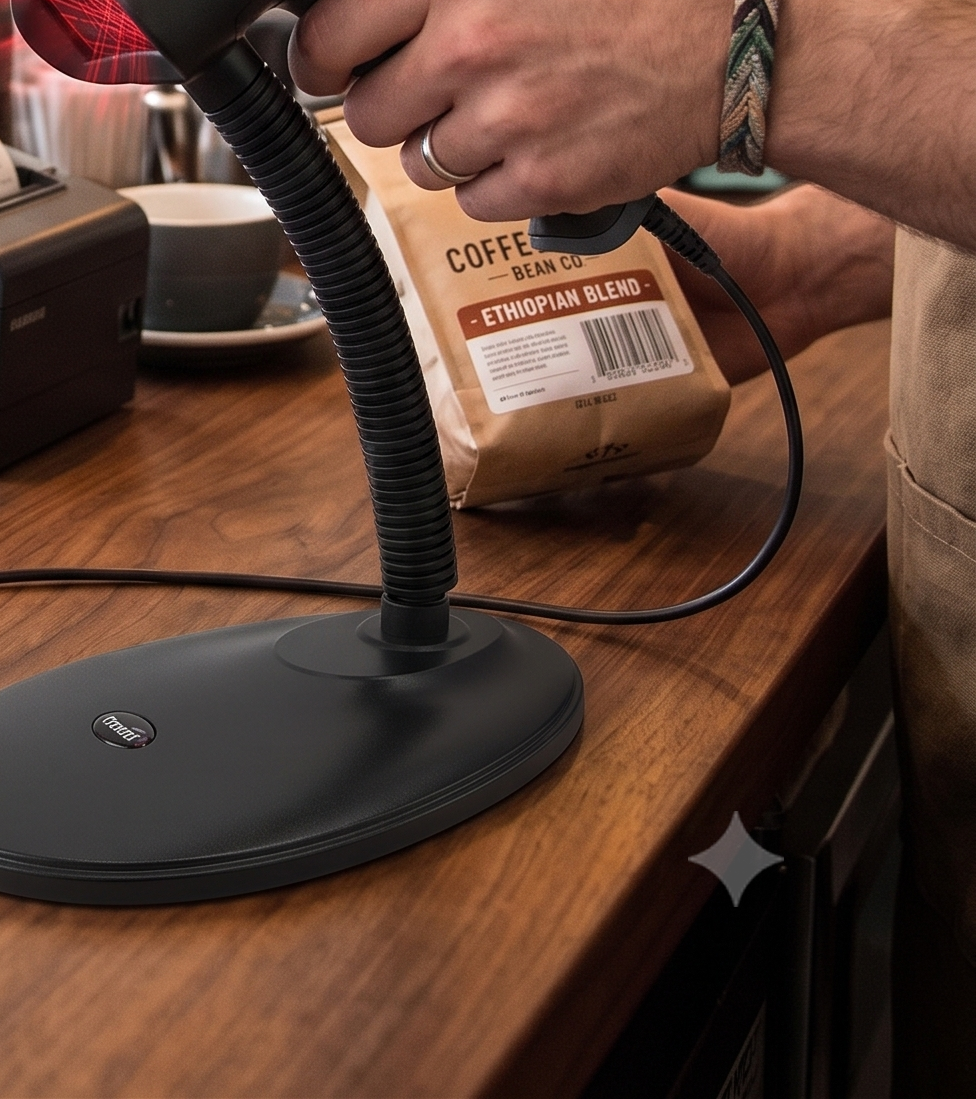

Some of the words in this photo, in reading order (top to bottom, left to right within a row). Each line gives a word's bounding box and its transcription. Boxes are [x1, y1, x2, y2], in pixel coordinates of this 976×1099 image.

[446, 231, 548, 274] COFFE
[511, 259, 557, 281] BEAN
[481, 288, 581, 327] ETHIOPIAN
[582, 277, 641, 304] BLEND
